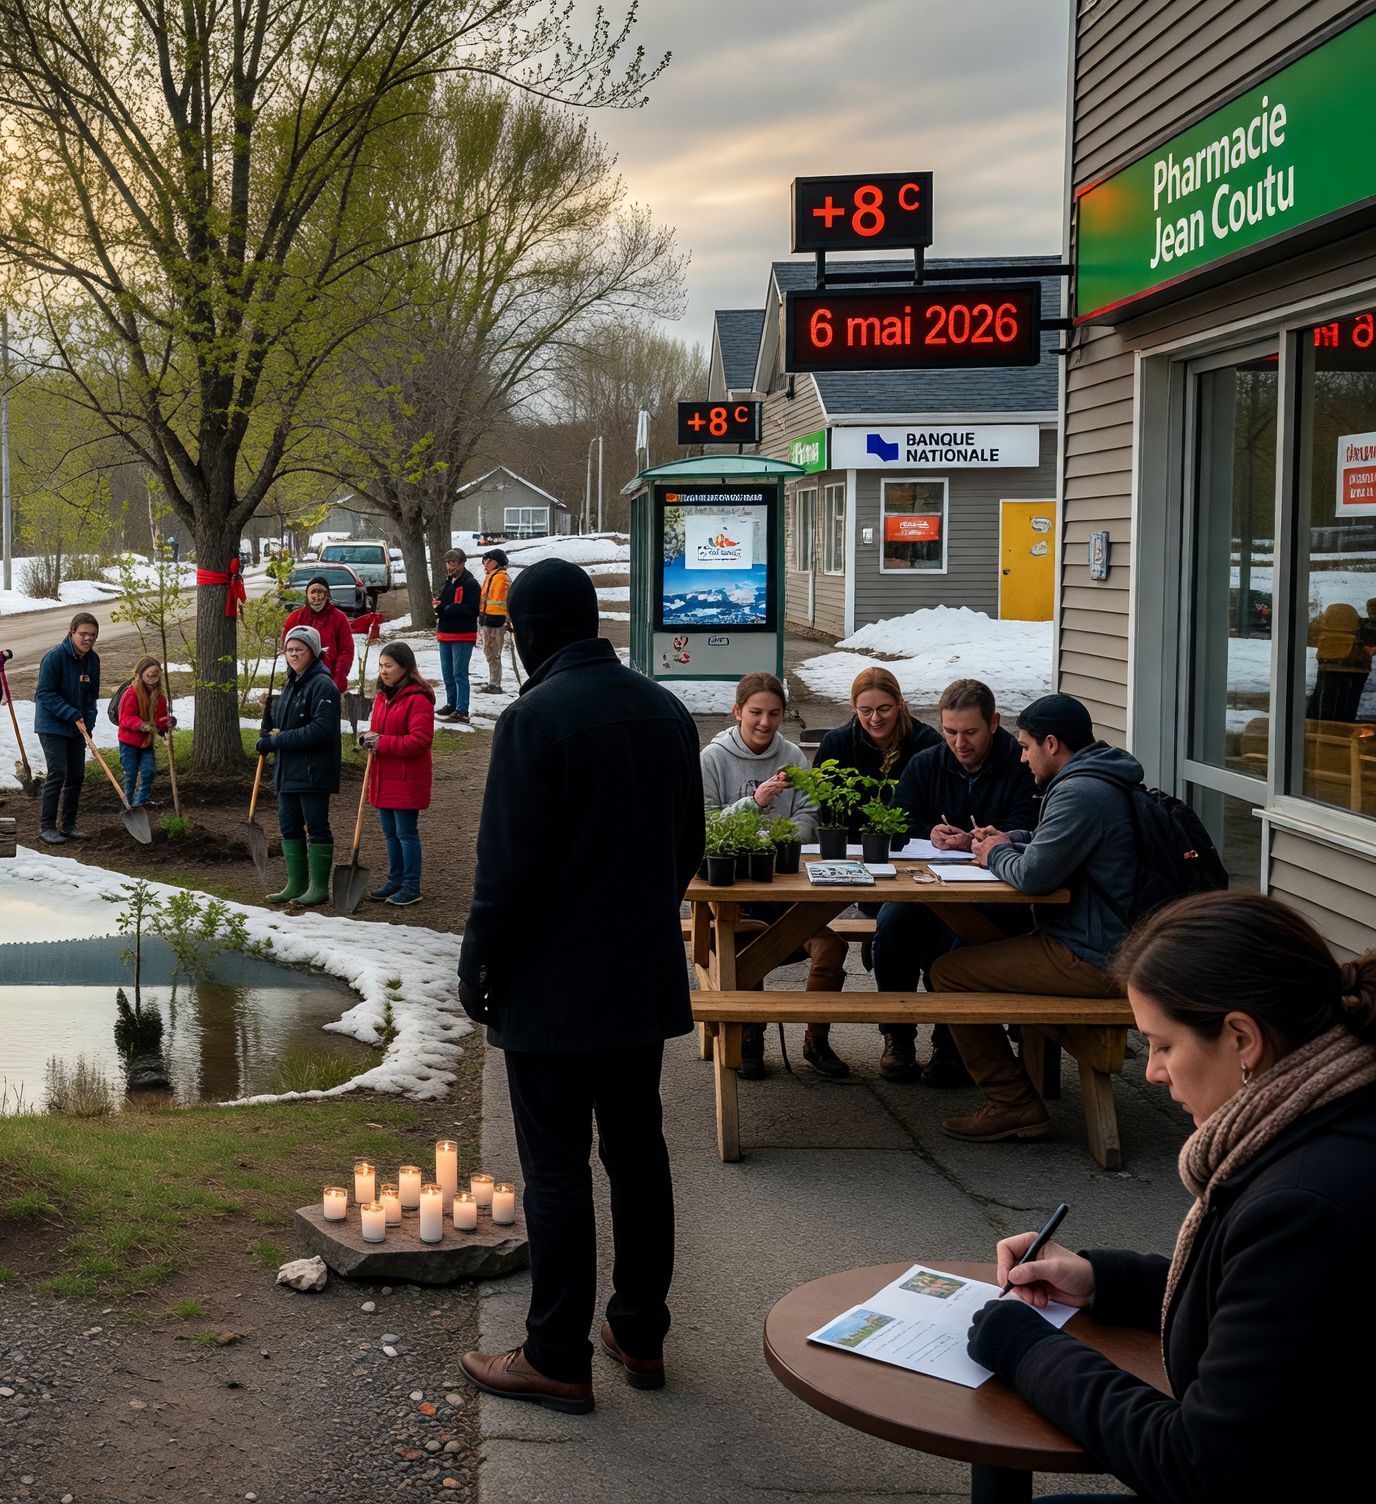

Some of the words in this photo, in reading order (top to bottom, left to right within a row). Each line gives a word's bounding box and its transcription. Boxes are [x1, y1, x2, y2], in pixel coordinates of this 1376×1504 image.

[1153, 95, 1287, 211] Pharmacie
[812, 184, 885, 237] +8
[898, 182, 921, 211] C
[1150, 209, 1204, 269] Jean
[1211, 164, 1295, 239] Coutu
[810, 308, 833, 348] 6
[847, 305, 912, 347] mai
[924, 302, 1018, 345] 2026
[687, 406, 728, 437] +8
[734, 405, 749, 423] C
[906, 432, 975, 447] BANQUE
[906, 448, 1000, 463] NATIONALE
